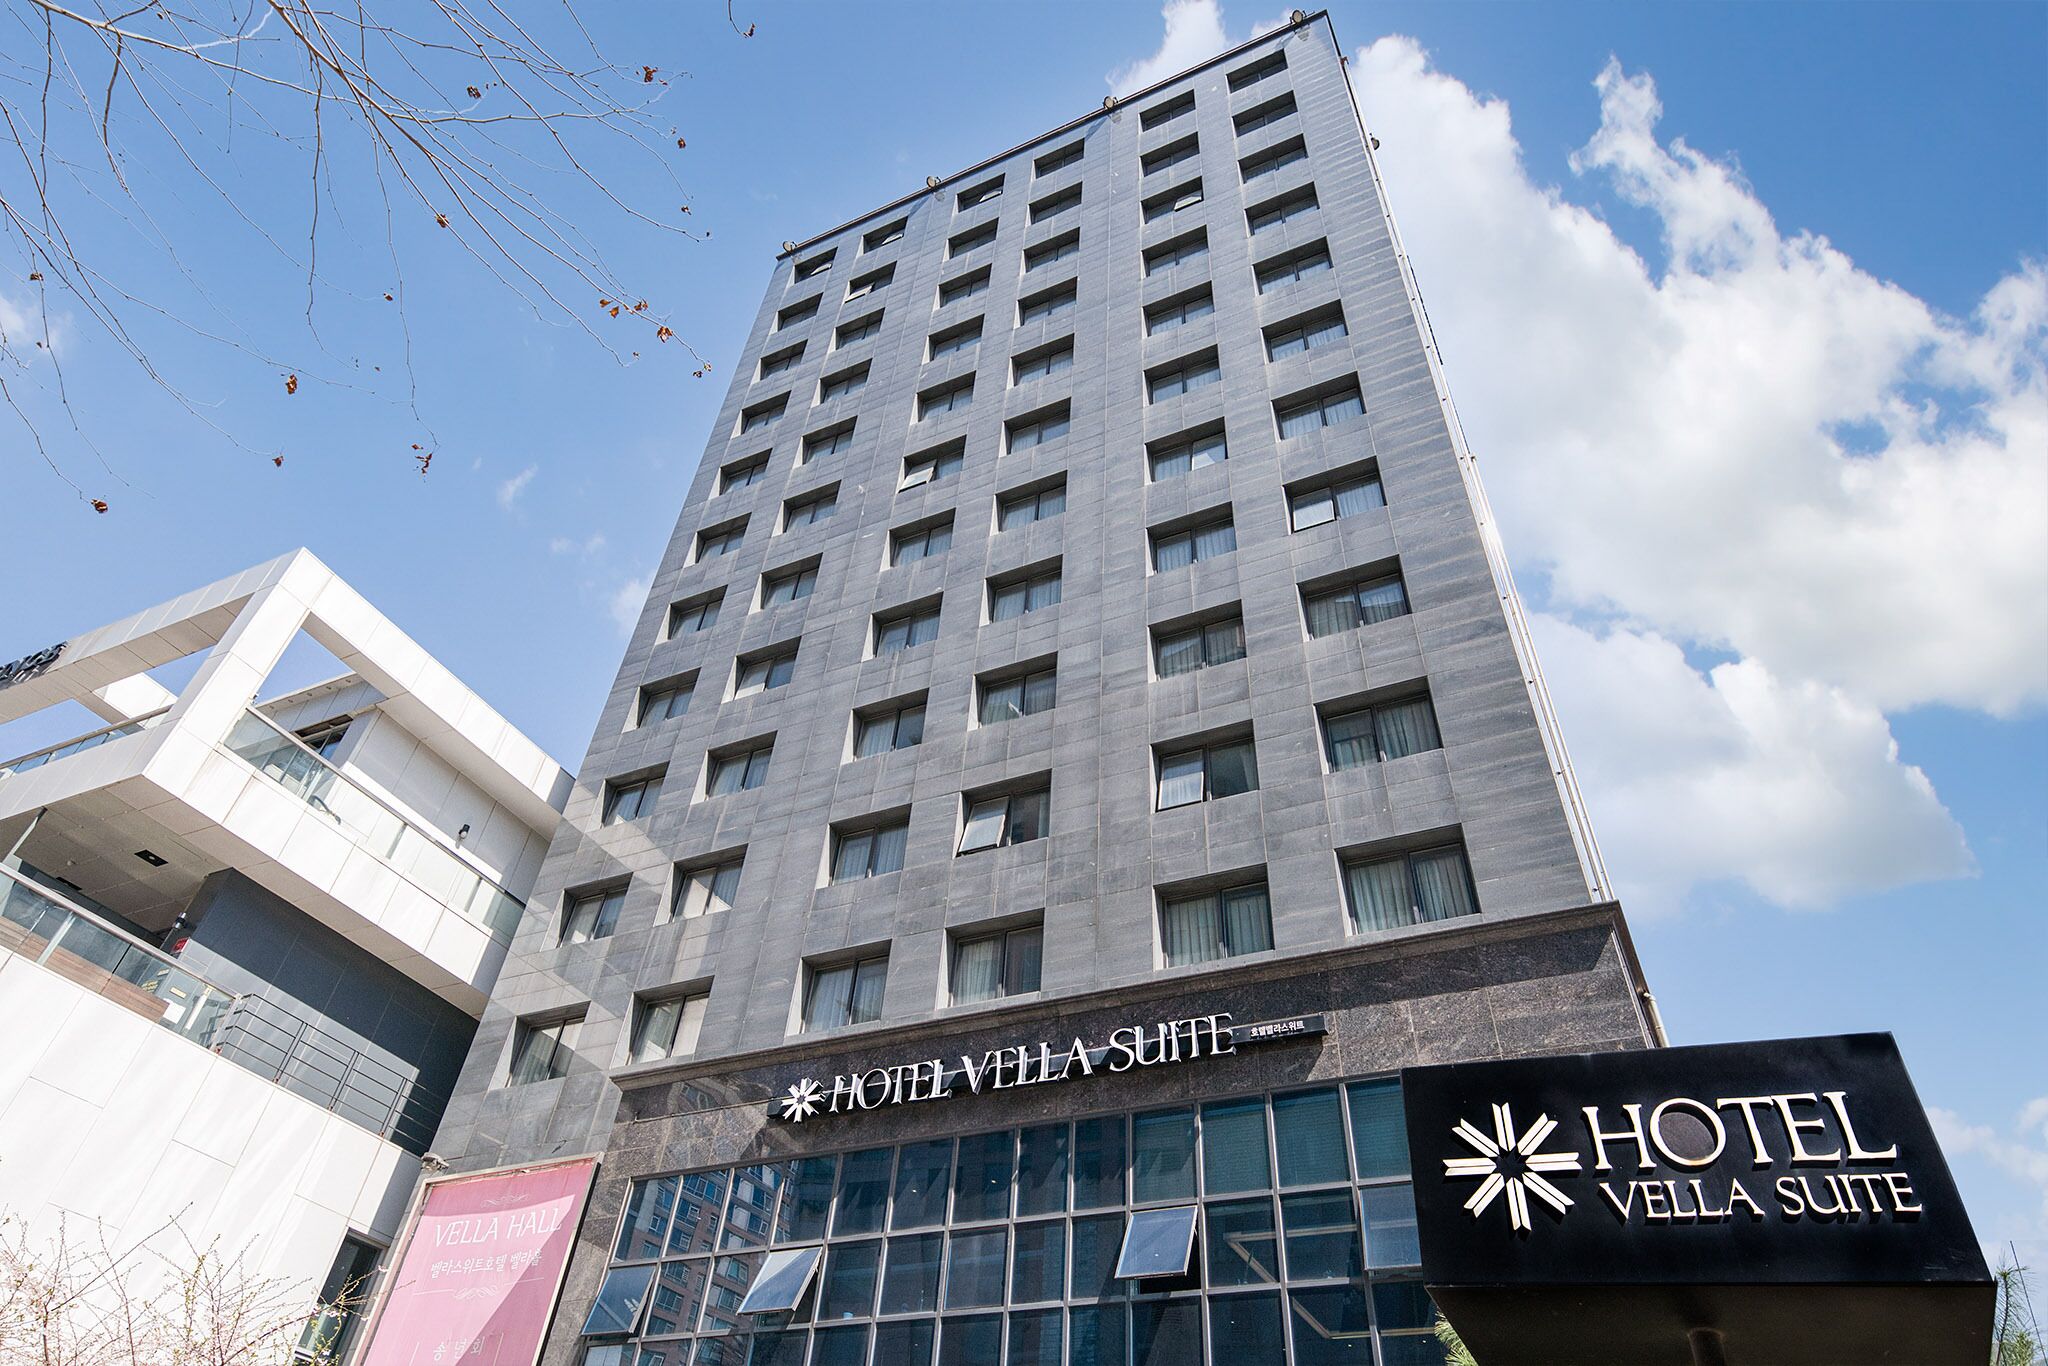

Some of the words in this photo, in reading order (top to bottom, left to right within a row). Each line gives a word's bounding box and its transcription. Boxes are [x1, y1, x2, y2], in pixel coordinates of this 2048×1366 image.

[1250, 1020, 1305, 1037] 호텔벨라스위트
[829, 1058, 952, 1114] HOTEL
[961, 1035, 1095, 1096] VELLA
[1108, 1012, 1237, 1072] SUITE
[1581, 1090, 1897, 1171] HOTEL
[1599, 1176, 1767, 1222] VELLA
[1775, 1172, 1923, 1217] SUITE
[435, 1216, 498, 1248] VELLA
[506, 1208, 562, 1240] HALL
[431, 1253, 507, 1279] 벨라스위트호텔
[510, 1248, 543, 1270] 벨라홀
